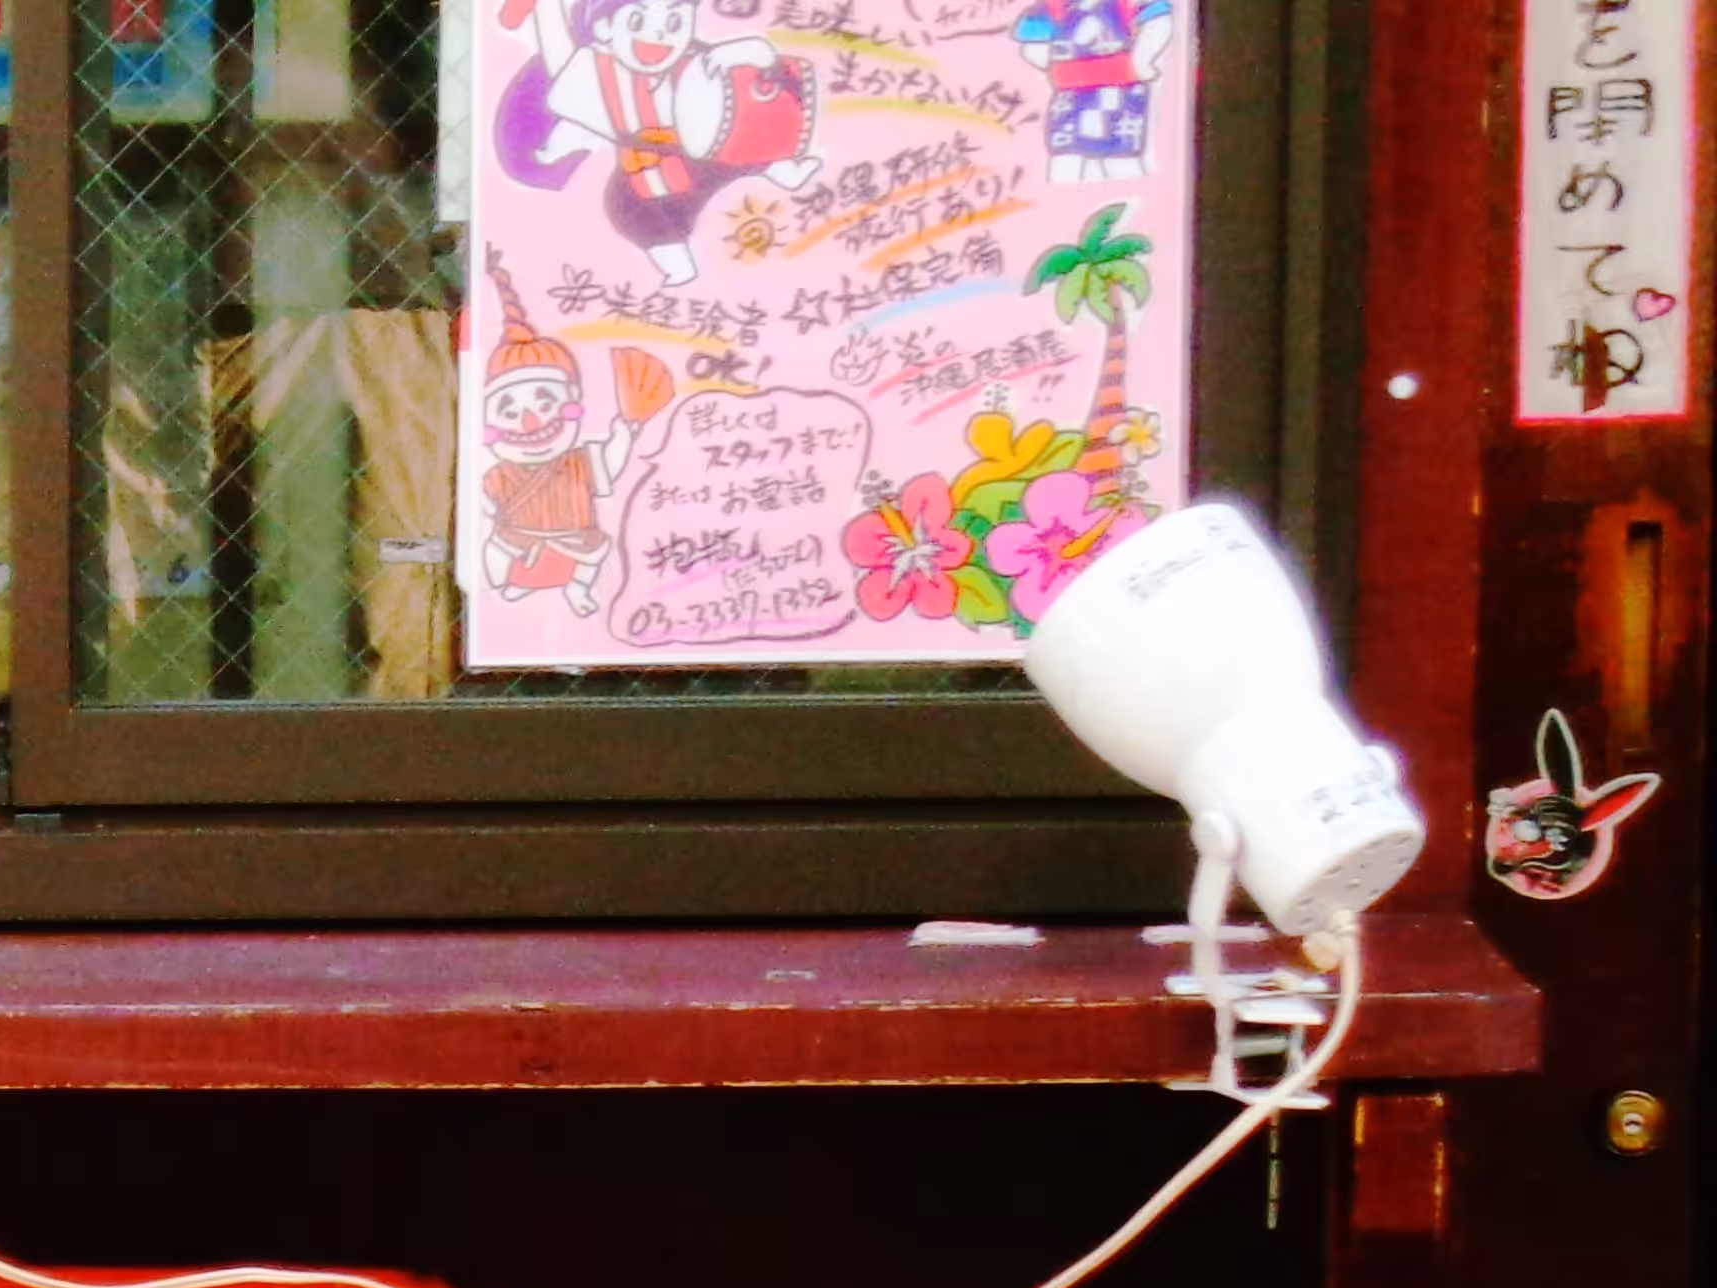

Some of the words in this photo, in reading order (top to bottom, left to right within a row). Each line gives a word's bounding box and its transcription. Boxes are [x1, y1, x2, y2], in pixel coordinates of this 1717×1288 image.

[832, 229, 1004, 320] 社保完備
[601, 282, 768, 347] 未経験者
[684, 350, 774, 386] OK!
[687, 401, 778, 438] 詳しくは
